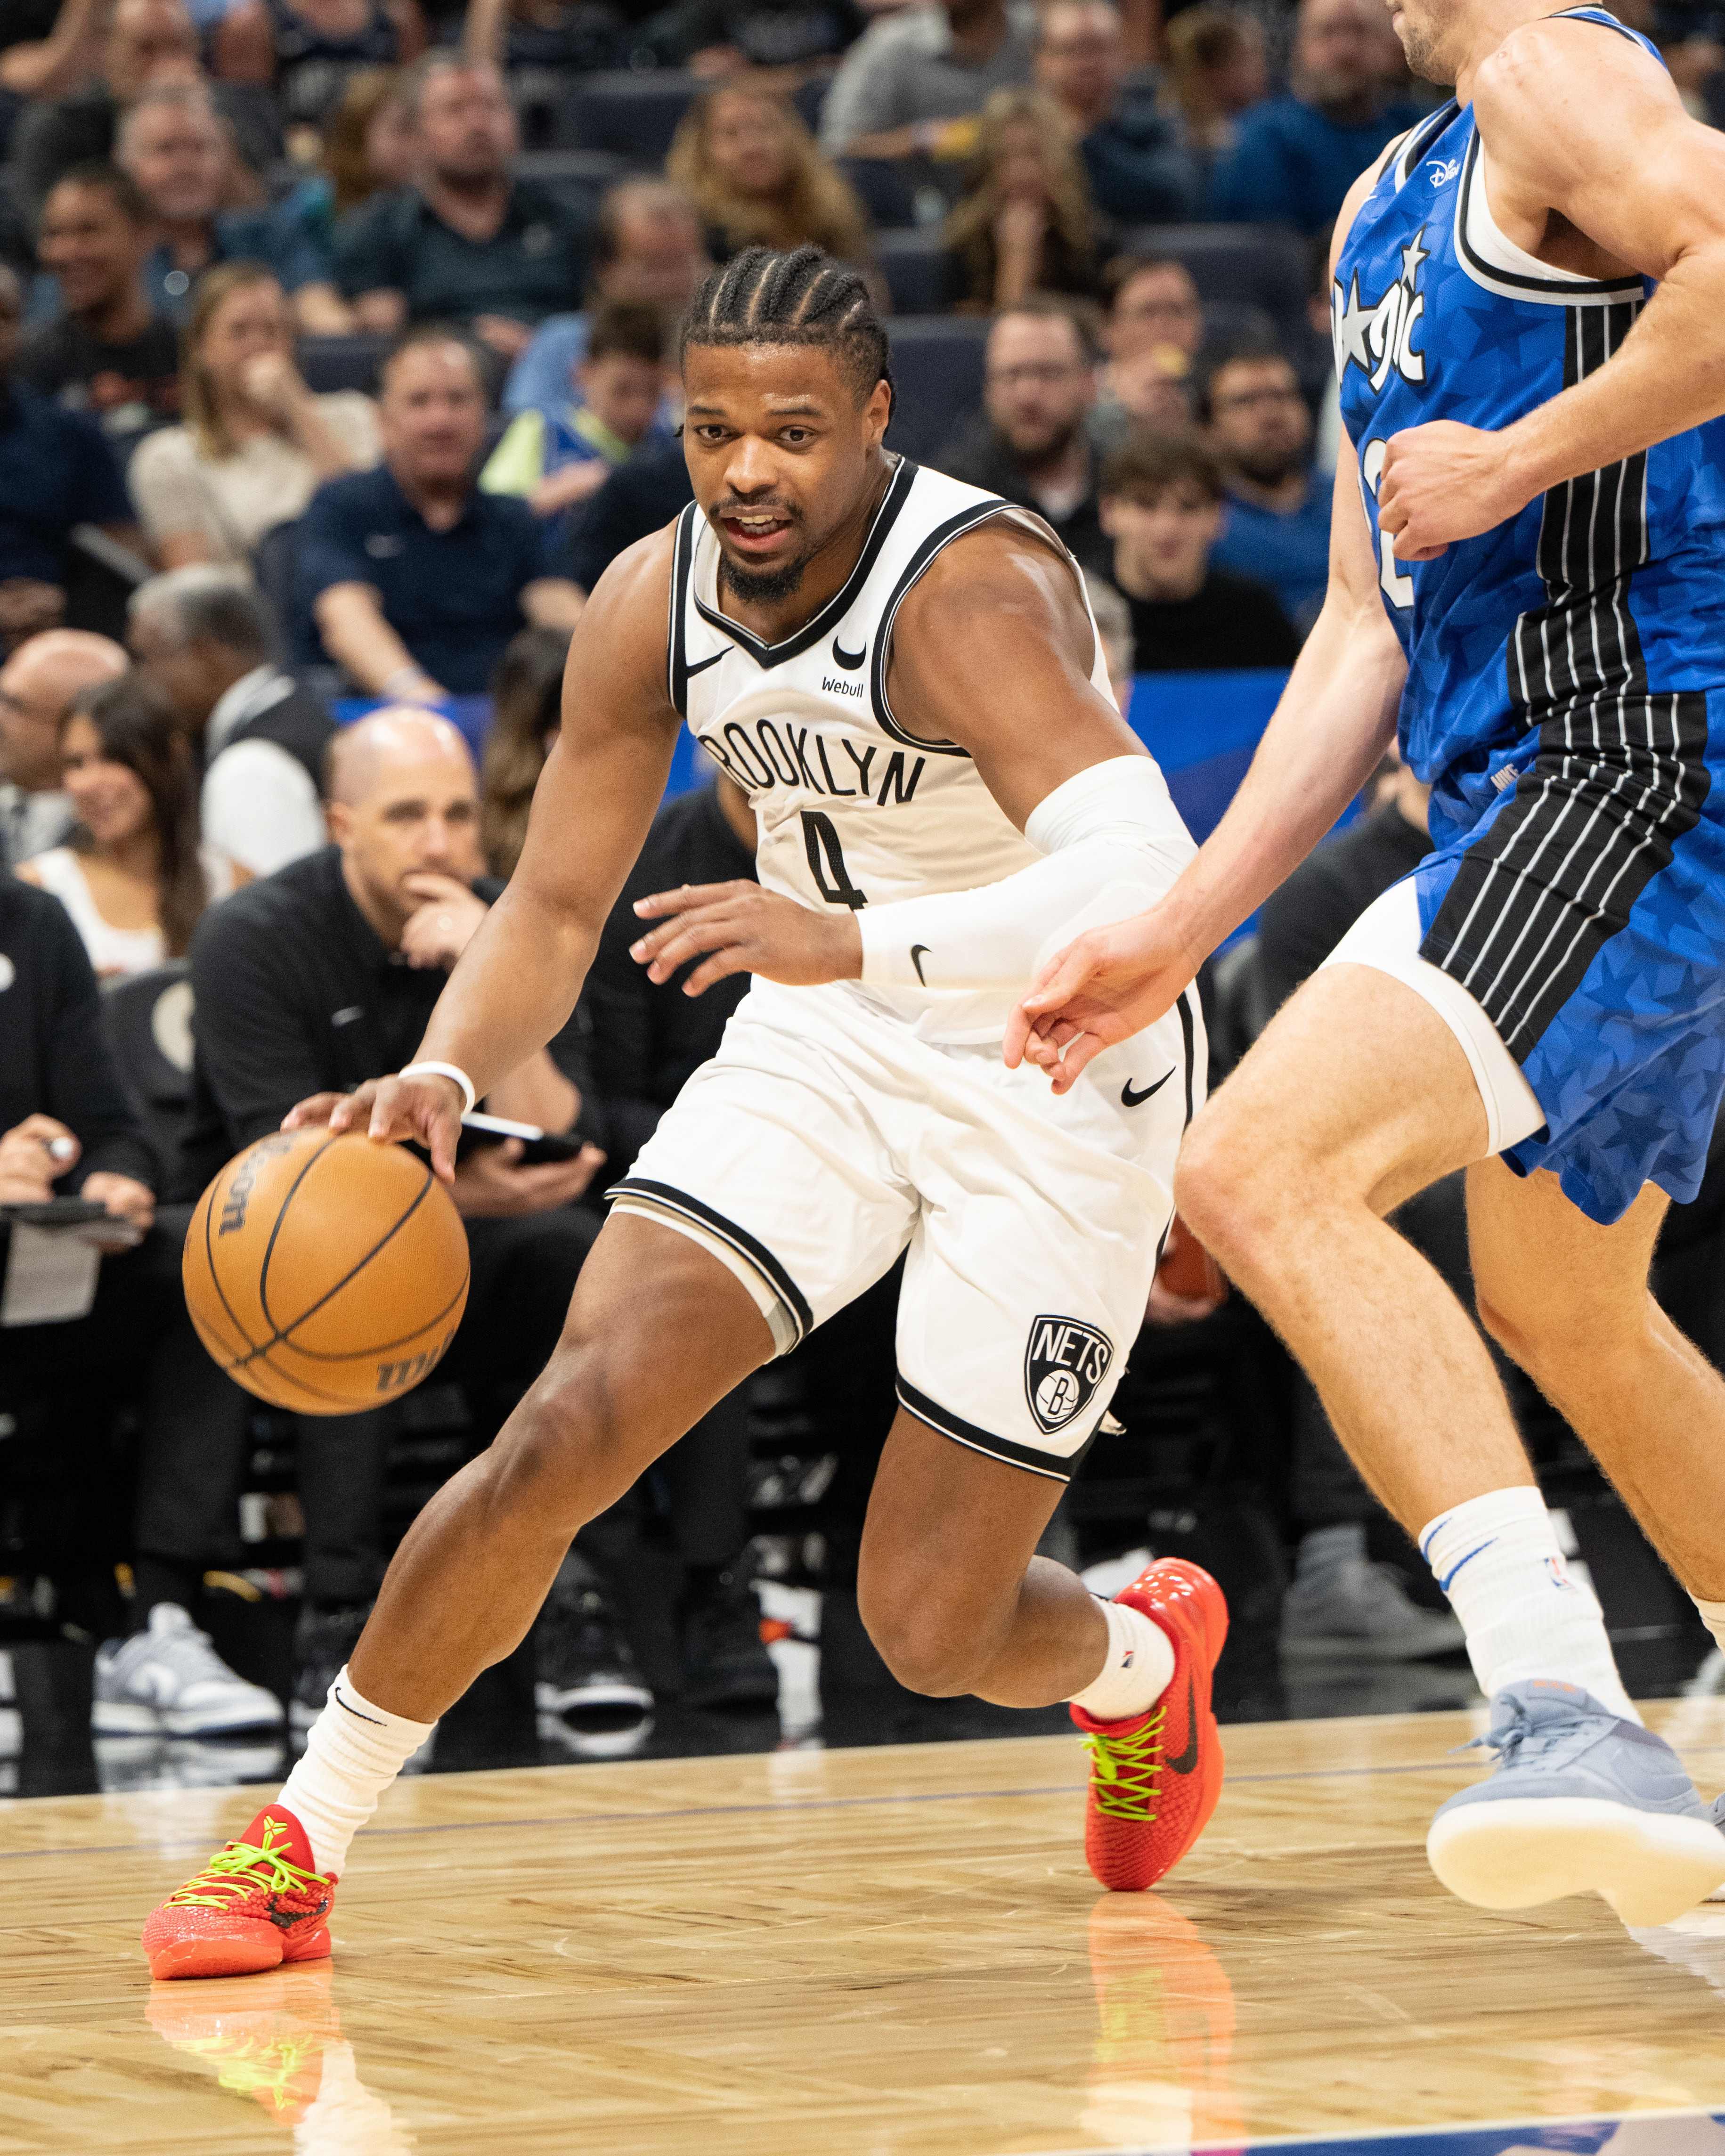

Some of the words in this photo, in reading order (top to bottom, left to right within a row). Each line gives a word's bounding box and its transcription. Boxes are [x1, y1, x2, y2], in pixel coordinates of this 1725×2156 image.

[822, 676, 864, 698] Webull
[697, 719, 926, 806] ROOKLYN
[800, 811, 869, 911] 4
[1032, 1324, 1108, 1384] NETS
[1047, 1376, 1069, 1416] B
